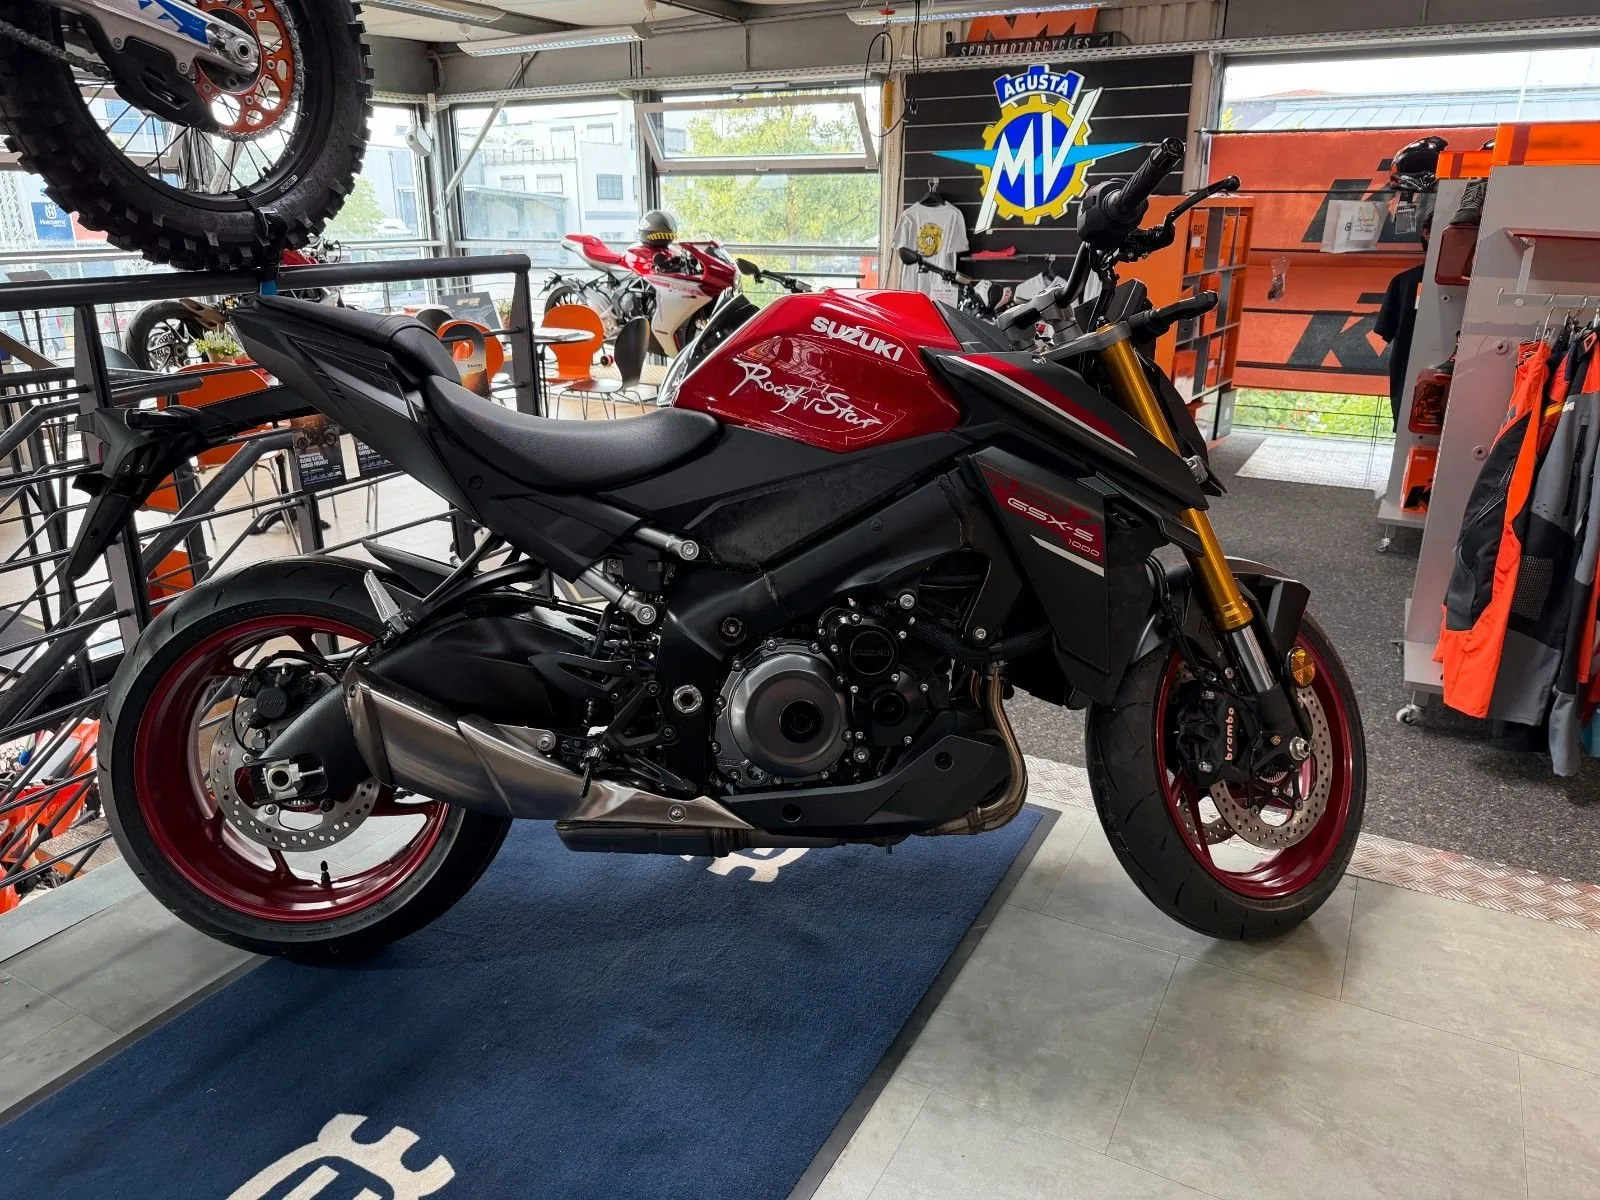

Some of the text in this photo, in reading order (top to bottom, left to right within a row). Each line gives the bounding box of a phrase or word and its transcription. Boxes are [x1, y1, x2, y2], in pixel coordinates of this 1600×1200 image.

[960, 37, 1091, 57] SPORTMOTORCYCLES
[1004, 74, 1069, 99] AGUSTA
[974, 87, 1102, 234] MV
[810, 316, 904, 362] SUZUKI
[1007, 497, 1095, 542] GSX-S
[1068, 538, 1100, 557] 1000
[1224, 707, 1235, 761] brembo
